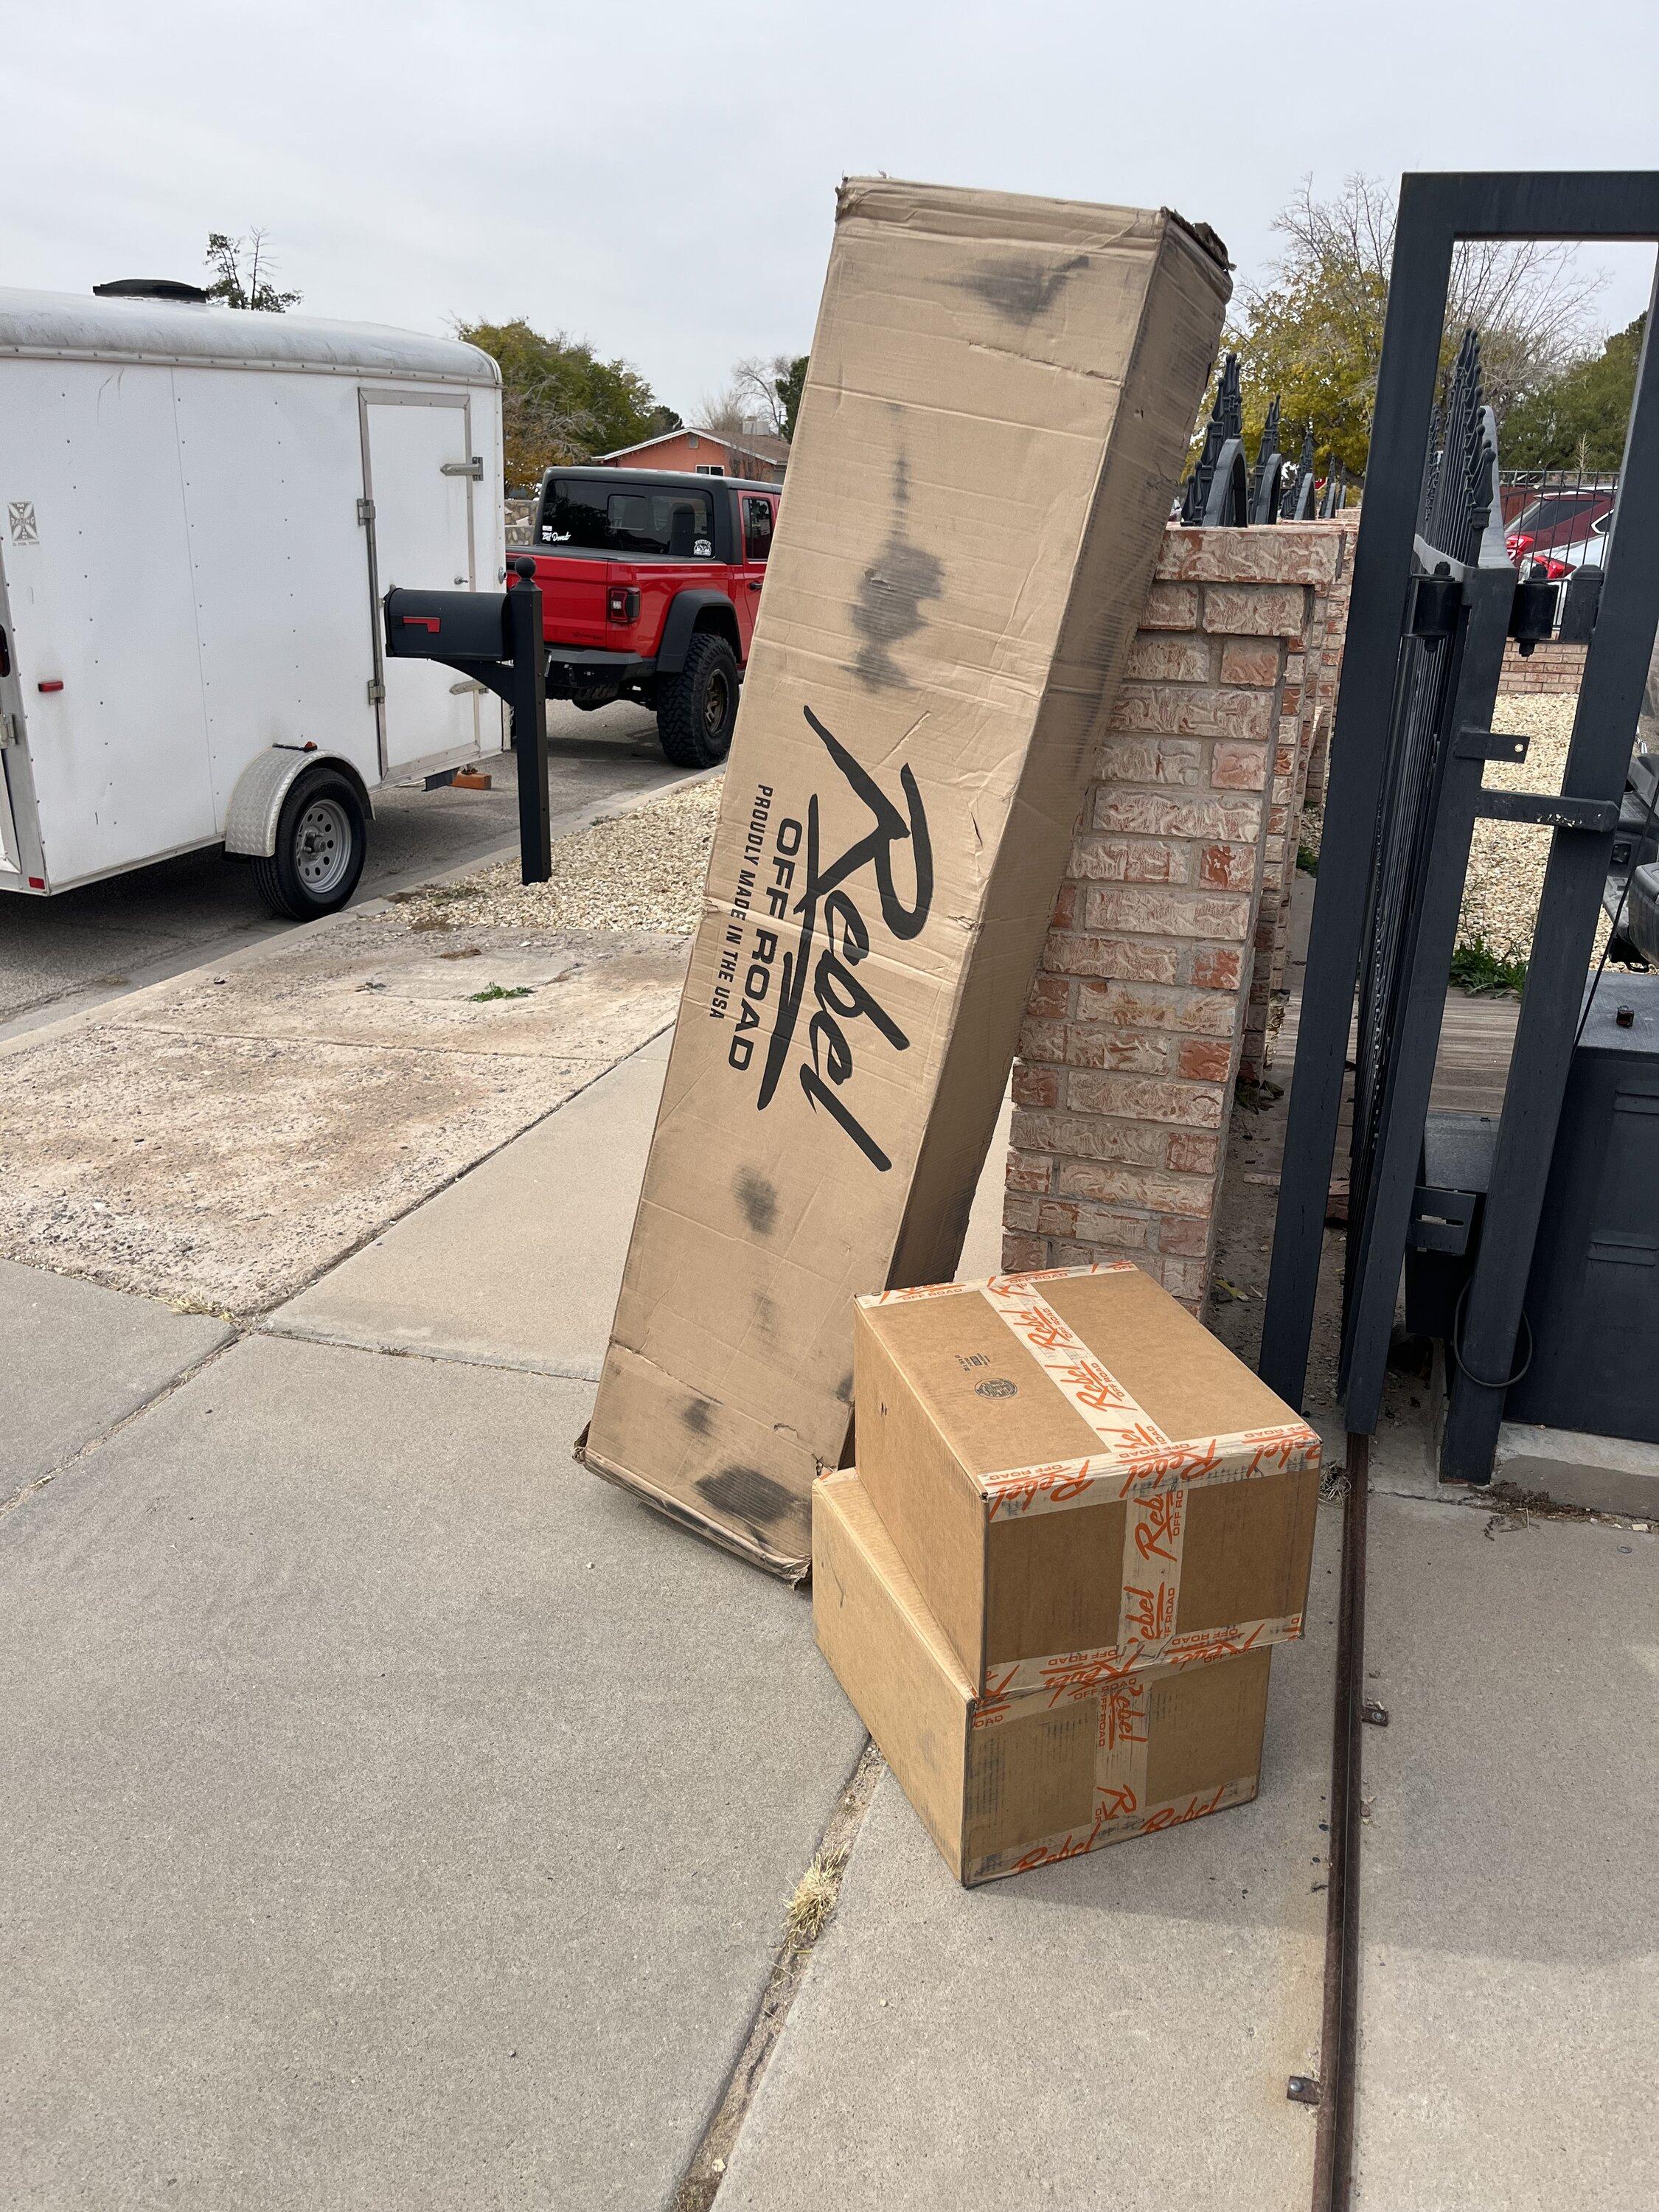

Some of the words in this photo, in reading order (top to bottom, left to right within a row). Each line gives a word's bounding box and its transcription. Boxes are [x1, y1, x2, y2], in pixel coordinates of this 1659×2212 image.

[743, 784, 774, 866] PROUDLY
[765, 818, 803, 920] OFF
[730, 869, 756, 921] MADE
[726, 924, 743, 945] IN
[795, 704, 934, 1172] Rebel
[718, 950, 739, 983] THE
[709, 986, 731, 1019] USA
[728, 928, 779, 1071] ROAD
[1034, 1273, 1068, 1281] ROAD
[1043, 1307, 1061, 1326] ROAD
[999, 1310, 1085, 1352] Rebel
[1091, 1363, 1113, 1382] ROAD
[1044, 1364, 1138, 1413] Rebel
[1108, 1384, 1125, 1398] OFF
[1244, 1427, 1284, 1439] ROAD
[1119, 1447, 1161, 1459] ROAD
[1162, 1443, 1191, 1452] OFF
[989, 1470, 1032, 1481] ROAD
[1034, 1465, 1062, 1474] OFF
[1119, 1439, 1224, 1499] Rebel
[988, 1459, 1096, 1521] Rebel
[1175, 1489, 1183, 1509] RO
[1133, 1493, 1178, 1562] Reb
[1172, 1512, 1181, 1537] OFF
[1123, 1585, 1155, 1641] ebel
[1165, 1587, 1175, 1623] ROAD
[1171, 1632, 1210, 1646] ROAD
[1212, 1627, 1239, 1639] OFF
[1047, 1654, 1088, 1666] ROAD
[1091, 1649, 1119, 1660] OFF
[1074, 1687, 1098, 1701] OFF
